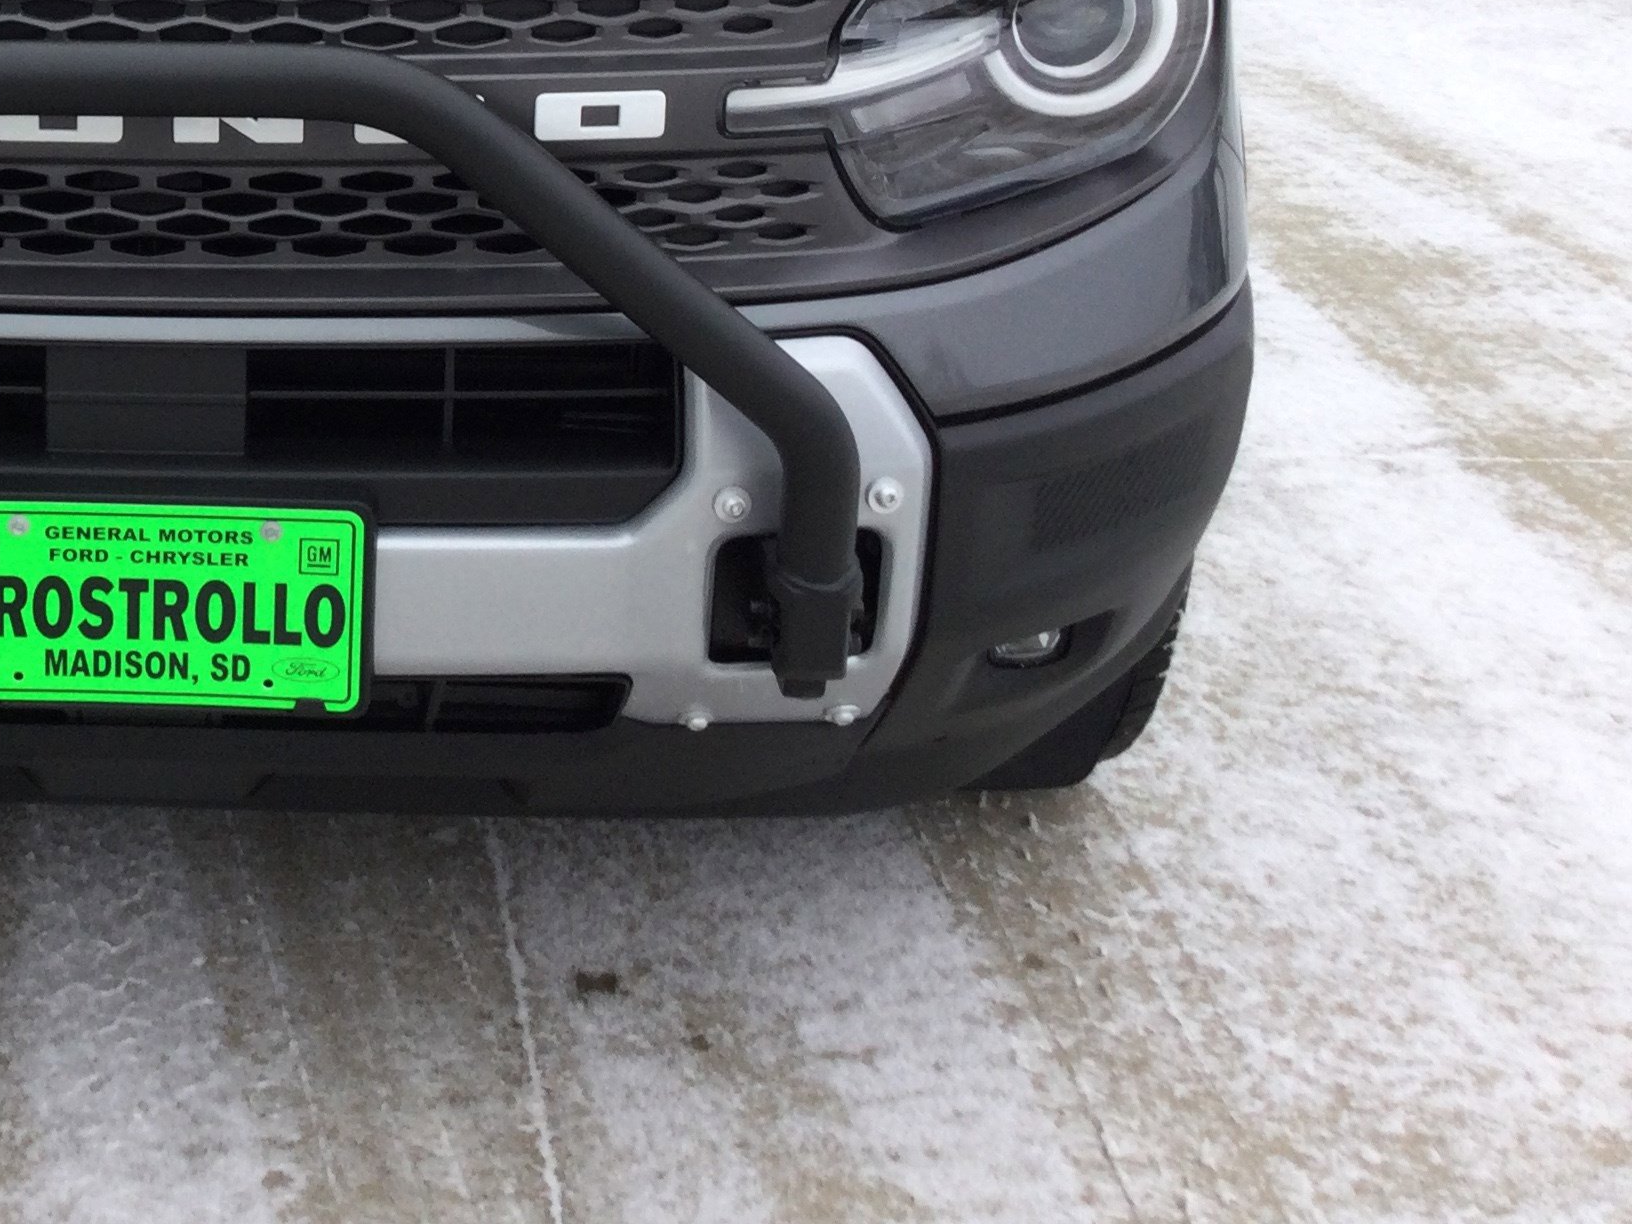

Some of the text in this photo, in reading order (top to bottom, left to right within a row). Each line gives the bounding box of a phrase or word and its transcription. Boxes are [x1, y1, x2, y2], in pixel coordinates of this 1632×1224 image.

[45, 526, 254, 545] GENERAL MOTORS
[48, 548, 109, 563] FORD
[130, 550, 249, 567] CHRYSLER
[306, 546, 332, 563] GM
[44, 649, 252, 686] MADISON, SD
[285, 662, 328, 677] Ford
